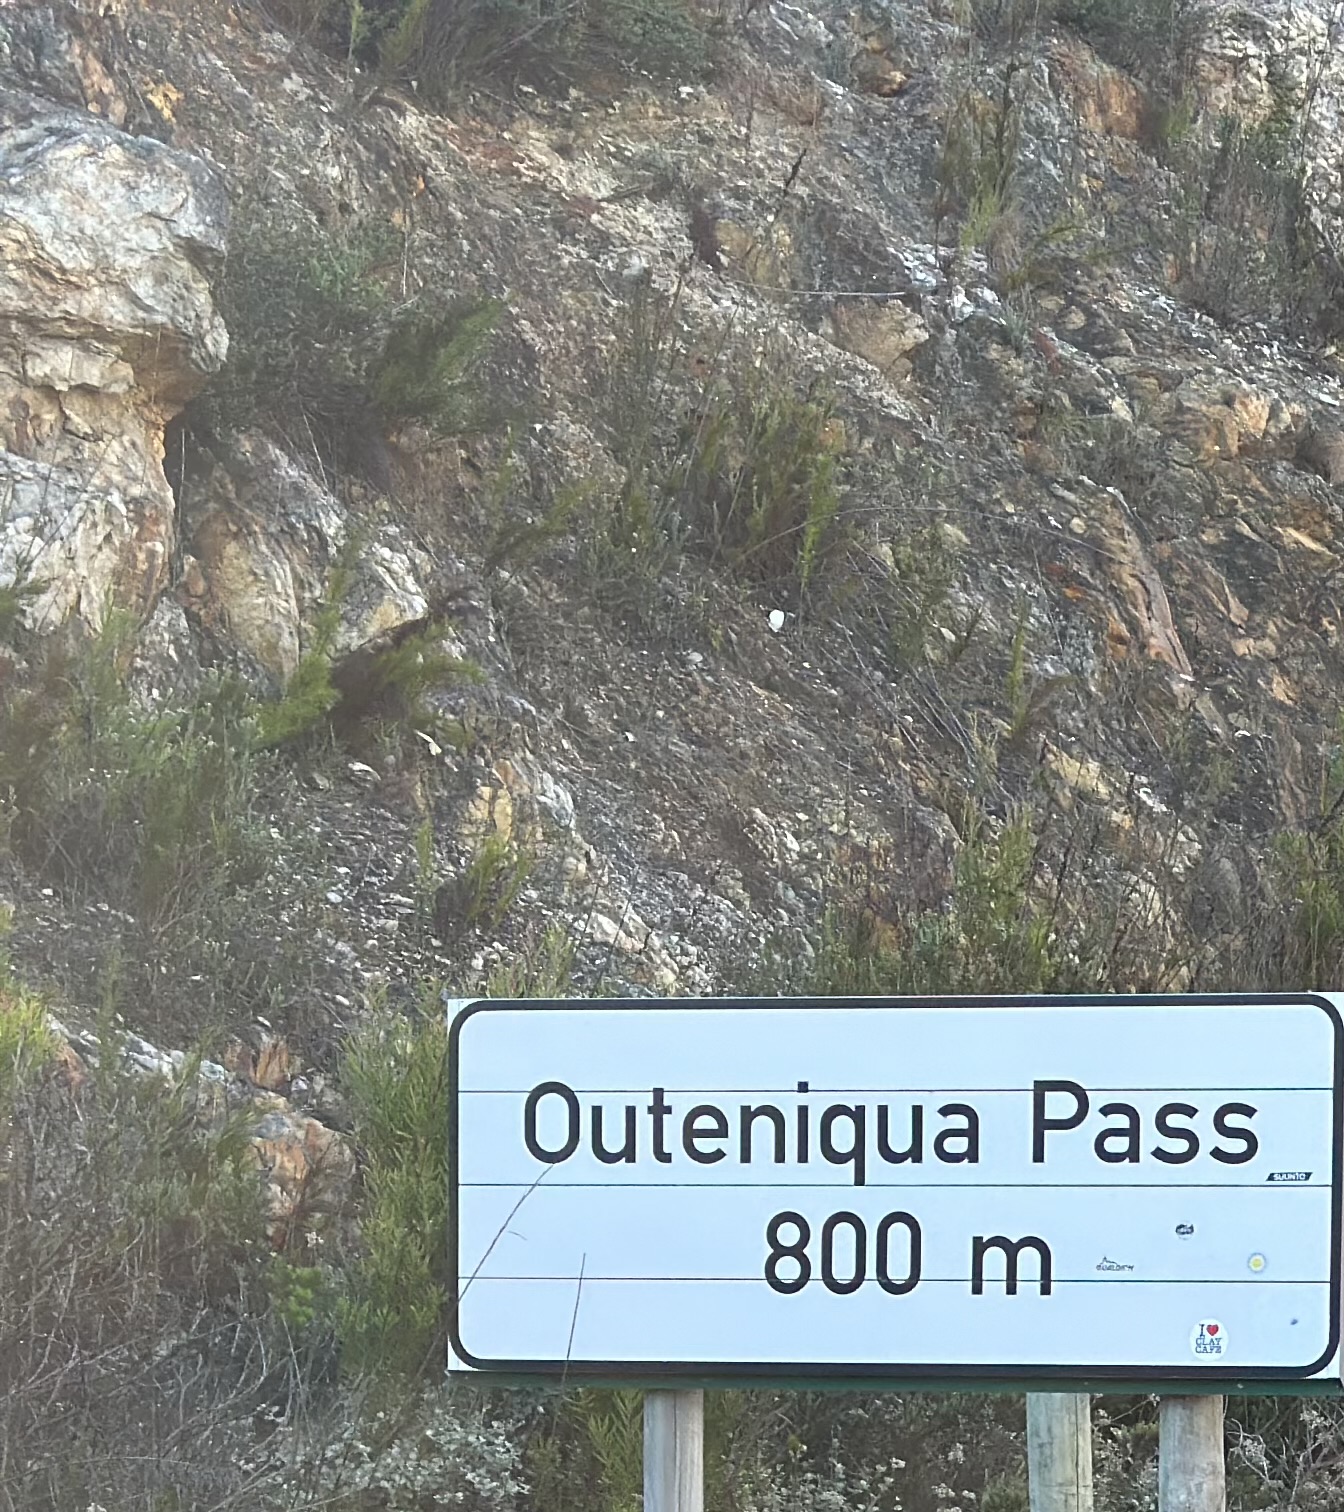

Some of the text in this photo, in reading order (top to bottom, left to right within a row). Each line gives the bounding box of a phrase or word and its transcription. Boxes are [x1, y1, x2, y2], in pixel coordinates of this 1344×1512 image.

[524, 1080, 1260, 1187] Outeniqua Pass
[764, 1211, 1053, 1296] 800 m
[1196, 1337, 1222, 1346] CLAY
[1199, 1324, 1206, 1337] I
